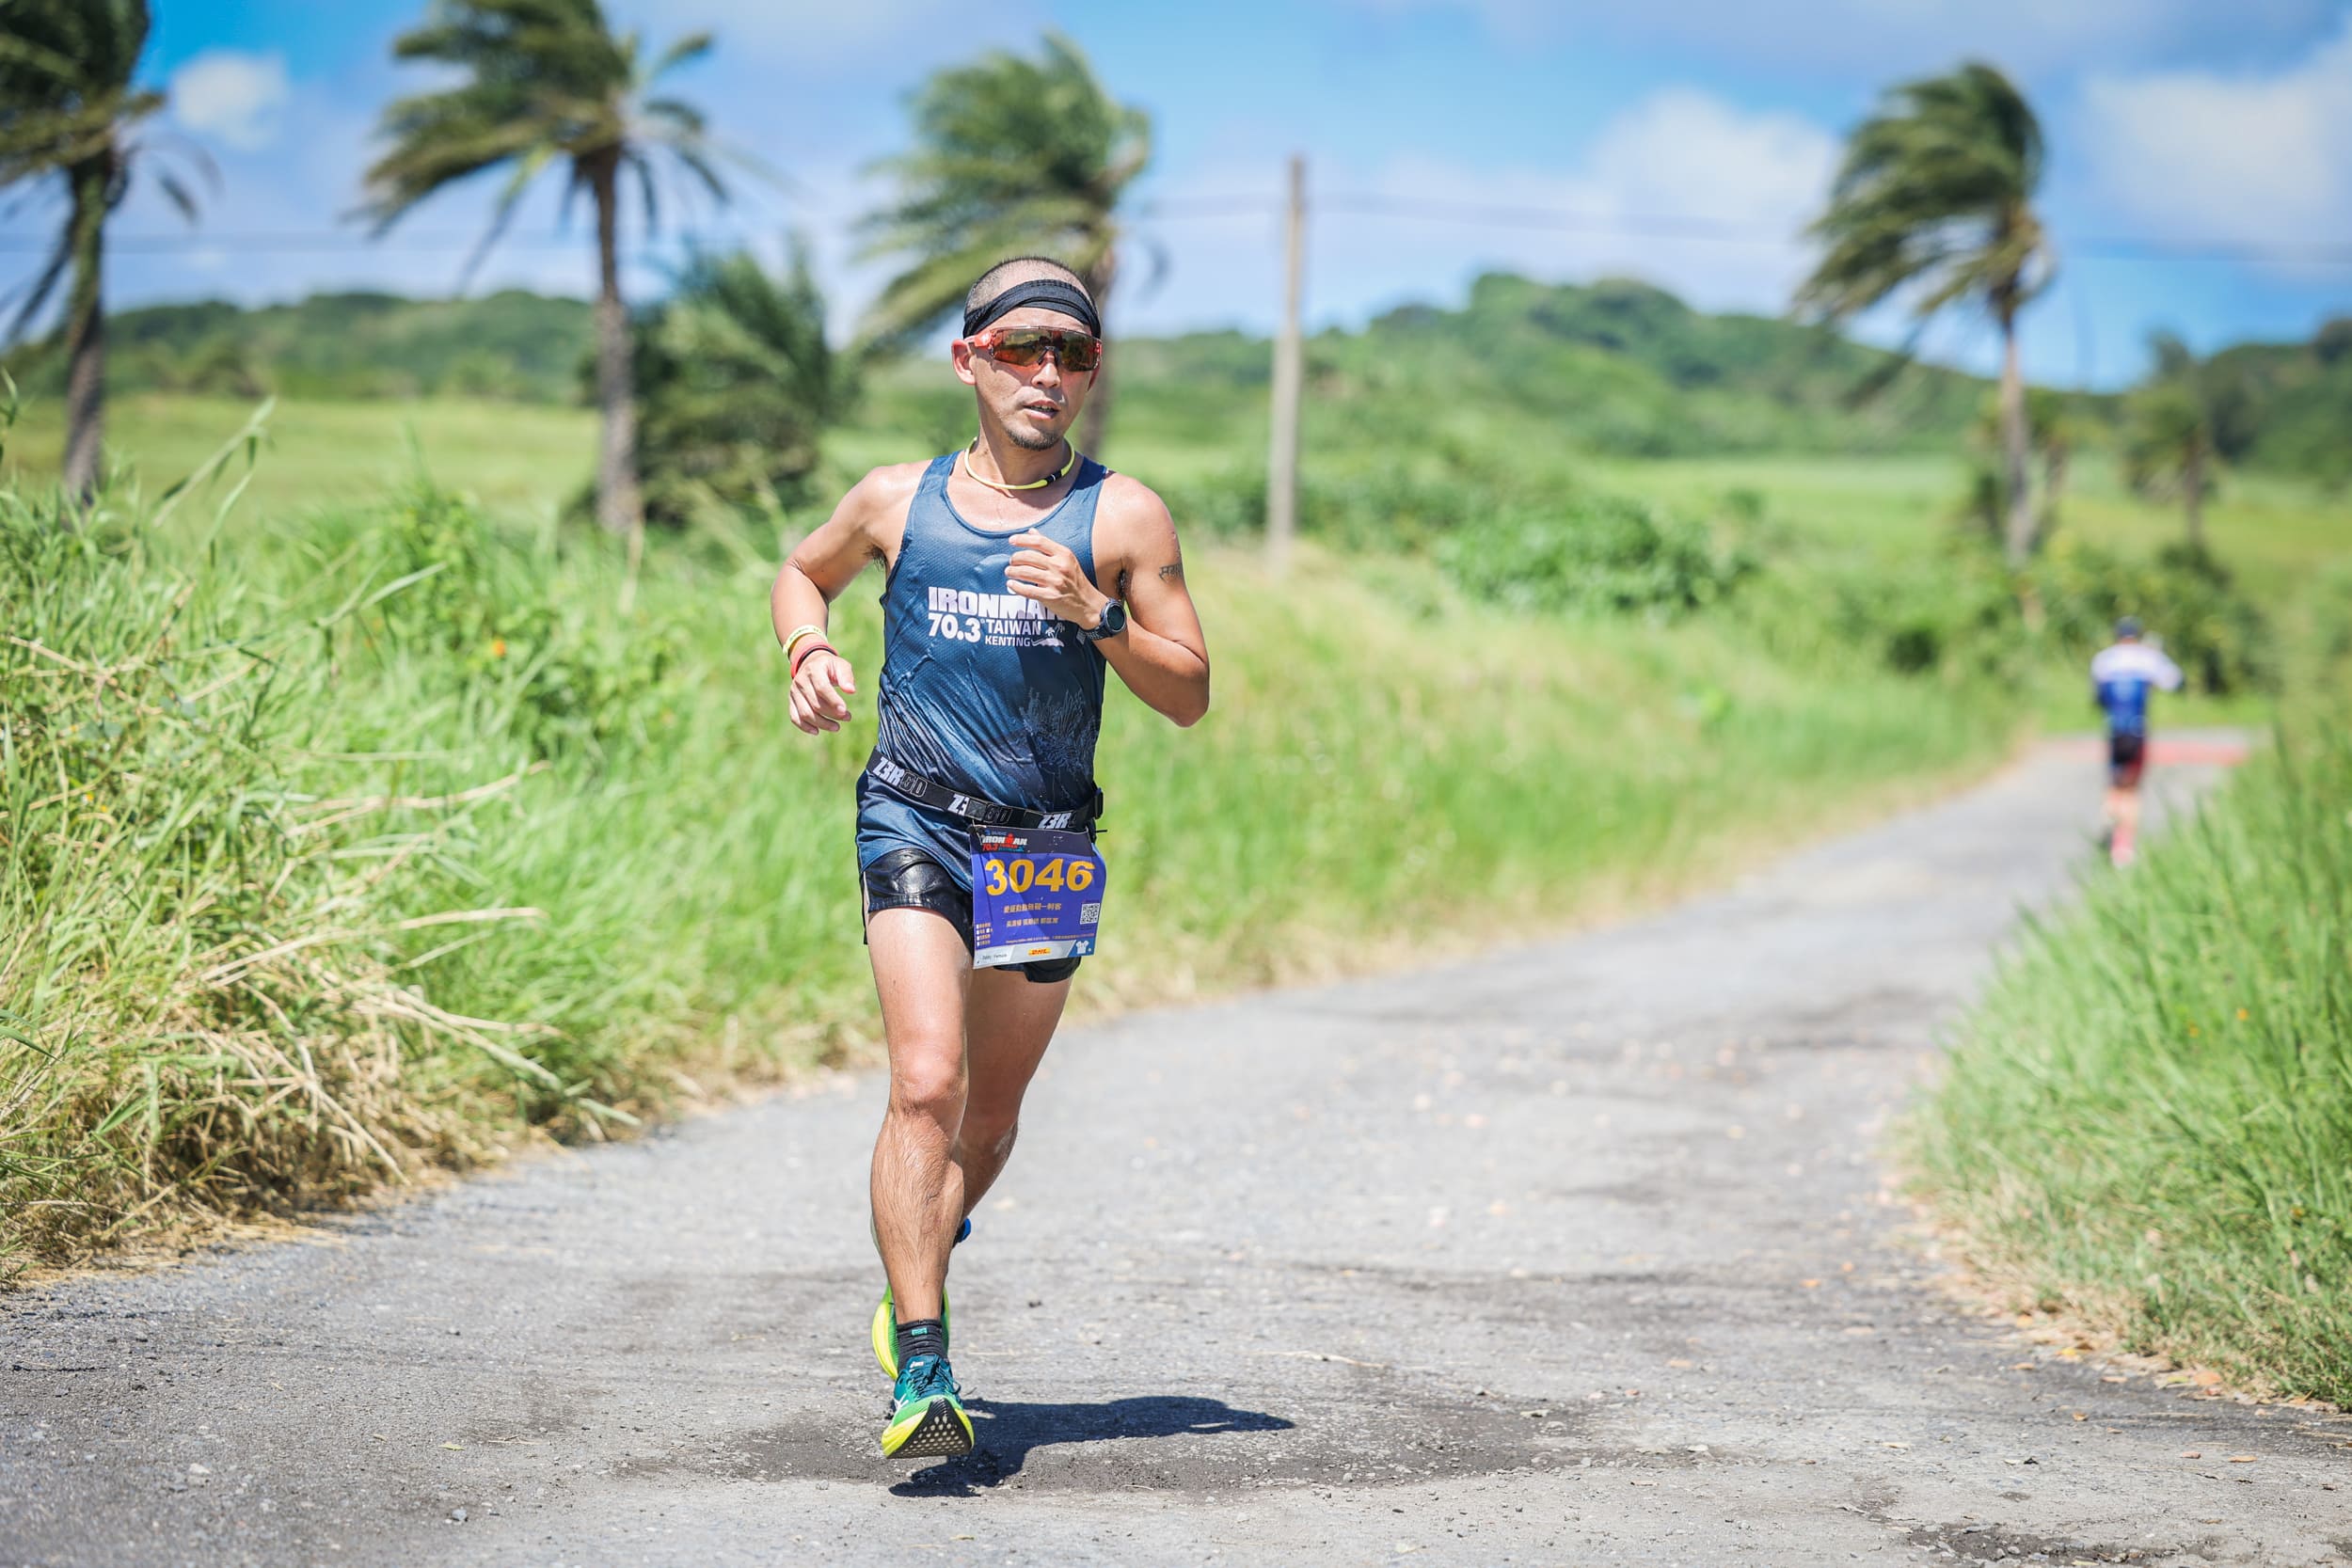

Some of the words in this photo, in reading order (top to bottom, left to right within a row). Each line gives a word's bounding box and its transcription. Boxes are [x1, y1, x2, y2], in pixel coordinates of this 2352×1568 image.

[928, 612, 981, 642] 70.3
[986, 619, 1041, 635] TAIWAN
[985, 635, 1031, 647] KENTING
[982, 834, 1027, 846] IRONMAN
[985, 858, 1095, 896] 3046
